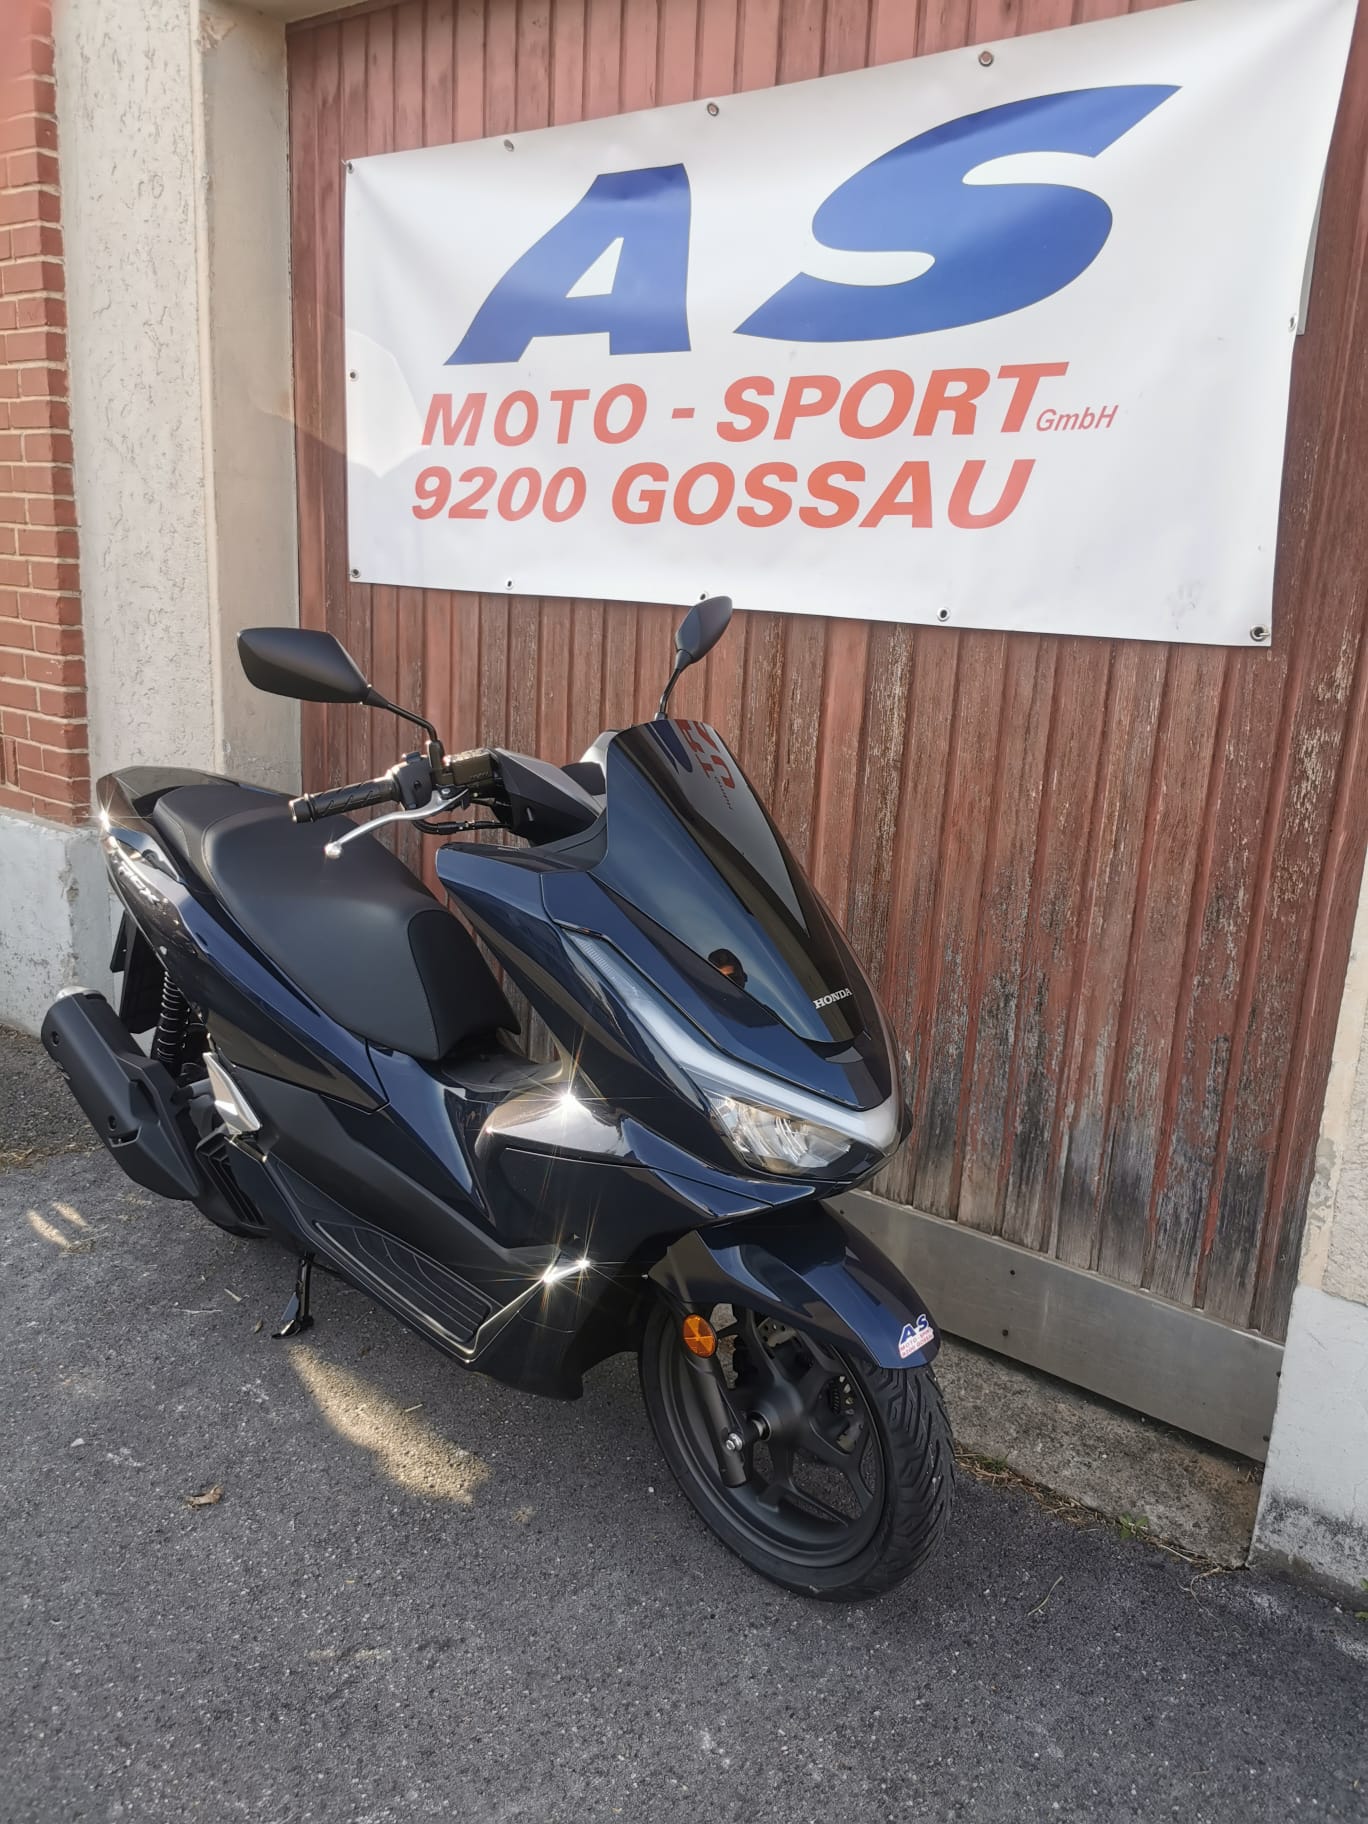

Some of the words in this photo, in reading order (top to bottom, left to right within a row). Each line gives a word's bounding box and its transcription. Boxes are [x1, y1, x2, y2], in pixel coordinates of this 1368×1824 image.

[421, 382, 648, 447] MOTO
[716, 361, 1070, 443] SPORT
[1035, 404, 1119, 433] GmbH
[411, 465, 588, 523] 9200
[611, 458, 1036, 530] GOSSAU
[812, 987, 853, 1010] HONDA
